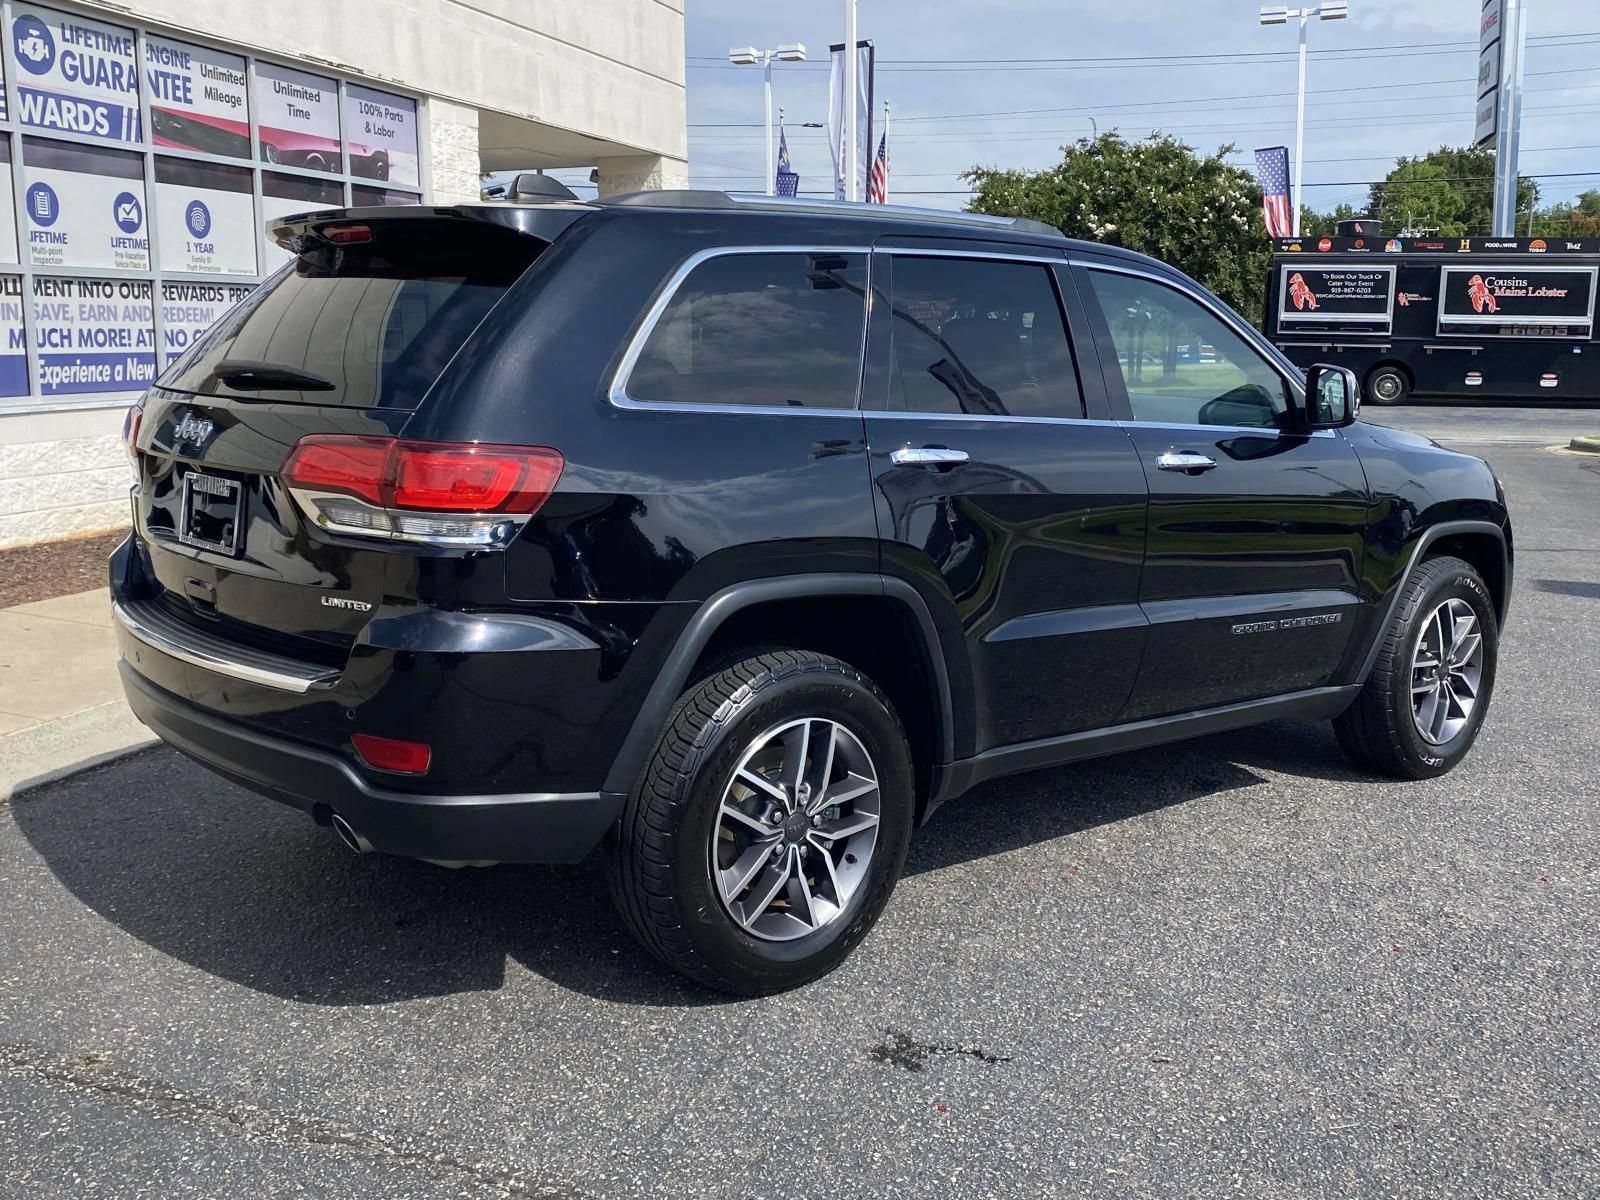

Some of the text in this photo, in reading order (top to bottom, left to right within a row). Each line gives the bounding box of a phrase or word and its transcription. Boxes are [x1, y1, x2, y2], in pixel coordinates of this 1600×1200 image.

[61, 22, 133, 57] LIFETIME
[200, 63, 245, 86] Unlimited
[204, 86, 242, 107] Mileage
[273, 80, 321, 103] Unlimited
[287, 103, 311, 120] Time
[359, 102, 404, 122] 100% Parts
[364, 122, 396, 139] & Labor
[110, 236, 149, 250] LIFETIME
[186, 241, 214, 254] 1 YEAR
[78, 281, 114, 299] INTO
[118, 282, 150, 300] OUR
[161, 285, 224, 302] REWARDS
[1484, 276, 1528, 288] Cousins
[1493, 286, 1568, 297] Maine Lobster
[79, 304, 118, 322] EARN
[121, 305, 152, 322] AND
[78, 328, 132, 348] MORE!
[164, 328, 188, 347] NO
[40, 359, 111, 389] Experience
[114, 364, 123, 382] a
[126, 357, 155, 381] New
[174, 409, 213, 447] Jeep
[320, 595, 373, 612] LIMITED
[1231, 612, 1343, 635] GRAND CHEROKEE
